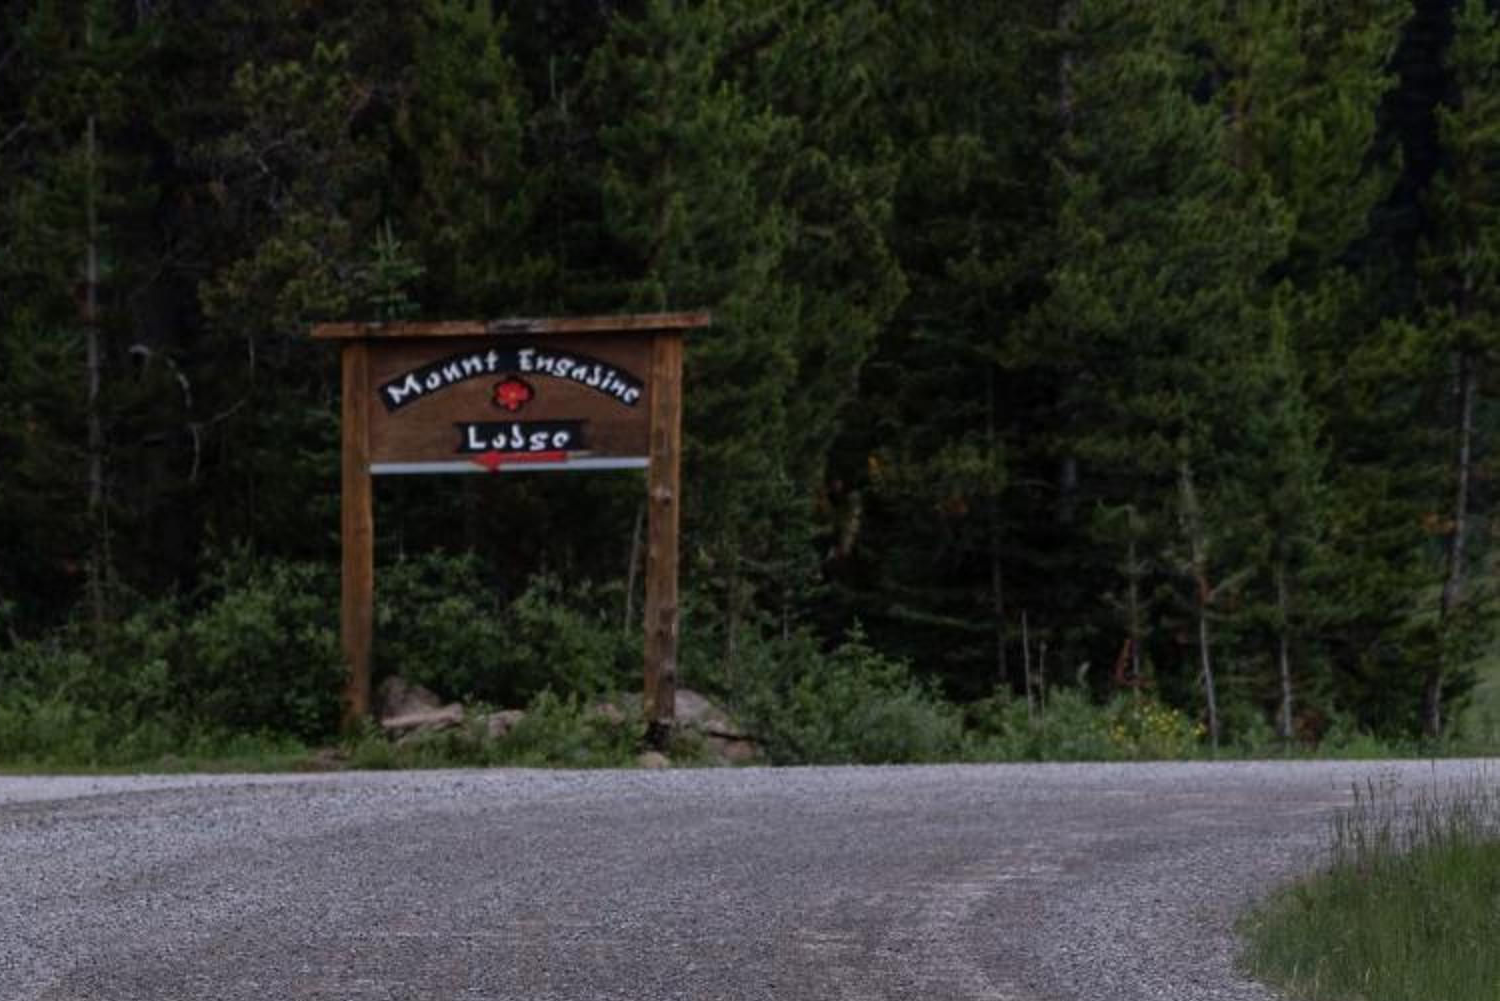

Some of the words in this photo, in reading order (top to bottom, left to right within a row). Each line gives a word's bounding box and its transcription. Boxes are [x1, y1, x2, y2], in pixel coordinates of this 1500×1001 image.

[387, 349, 499, 405] Mount
[517, 347, 640, 405] Engadine
[466, 423, 571, 451] Lodge
